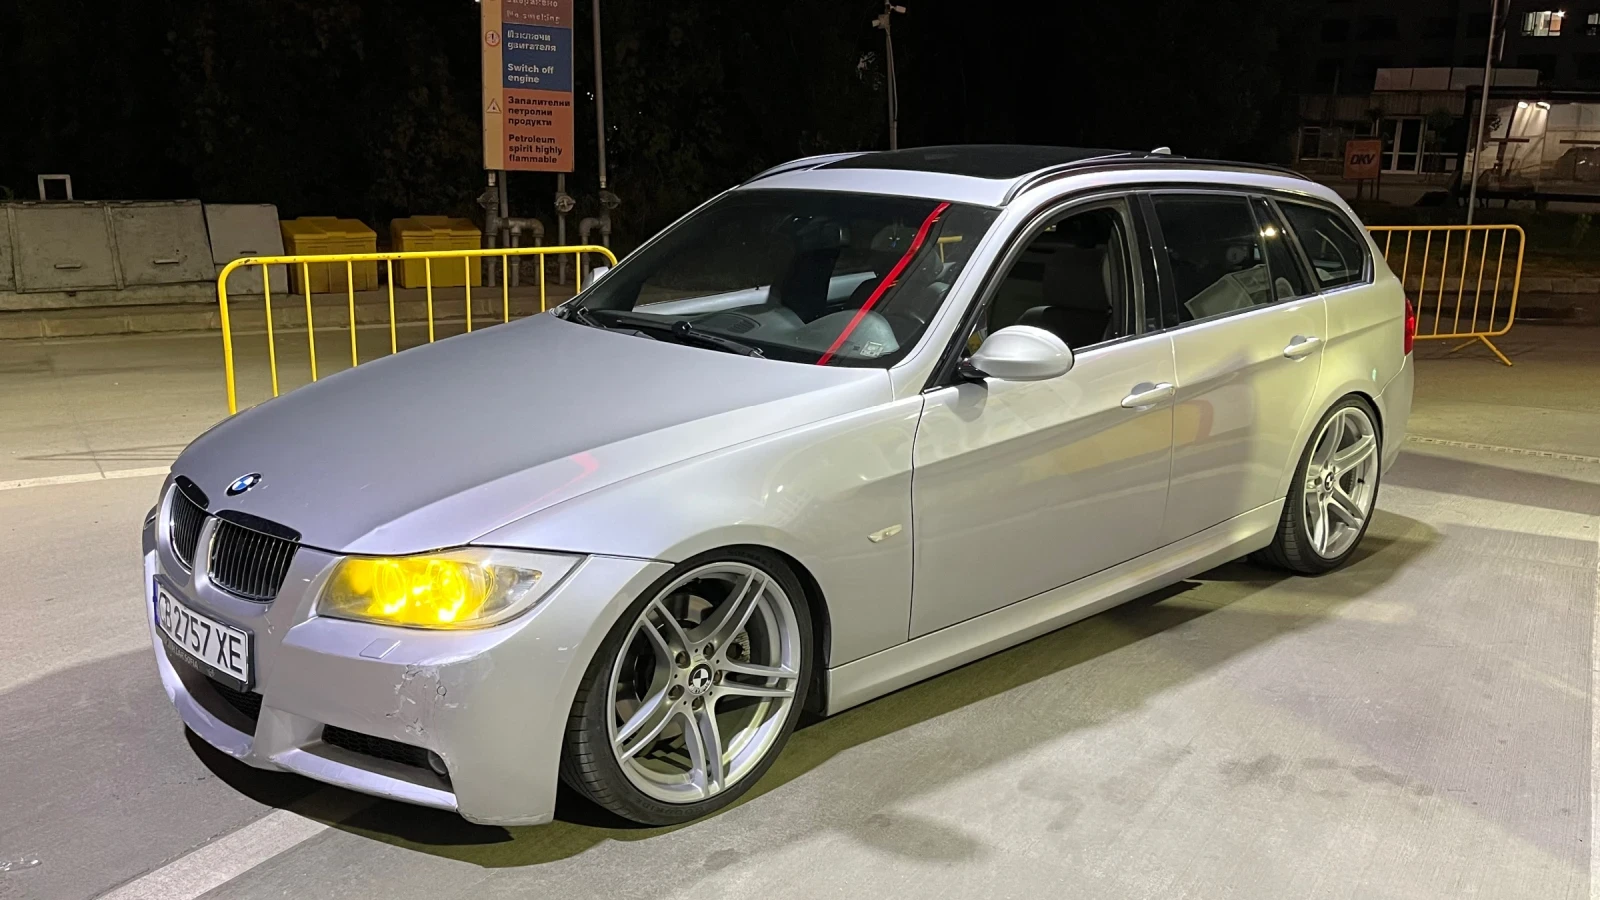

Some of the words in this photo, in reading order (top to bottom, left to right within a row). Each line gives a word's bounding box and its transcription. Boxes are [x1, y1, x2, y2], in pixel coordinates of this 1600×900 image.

[507, 29, 551, 41] Изключи
[507, 63, 539, 73] Switch
[541, 65, 554, 74] off
[507, 74, 540, 83] engine
[508, 96, 571, 106] Запалителни
[508, 108, 553, 116] петролни
[508, 118, 552, 126] продукти
[508, 134, 556, 143] Petroleum
[508, 144, 533, 153] spirit
[535, 145, 563, 155] highly
[509, 154, 557, 163] flammable
[1350, 153, 1376, 165] DKV
[159, 591, 172, 633] CB
[174, 605, 211, 657] 2757
[216, 627, 243, 675] XE
